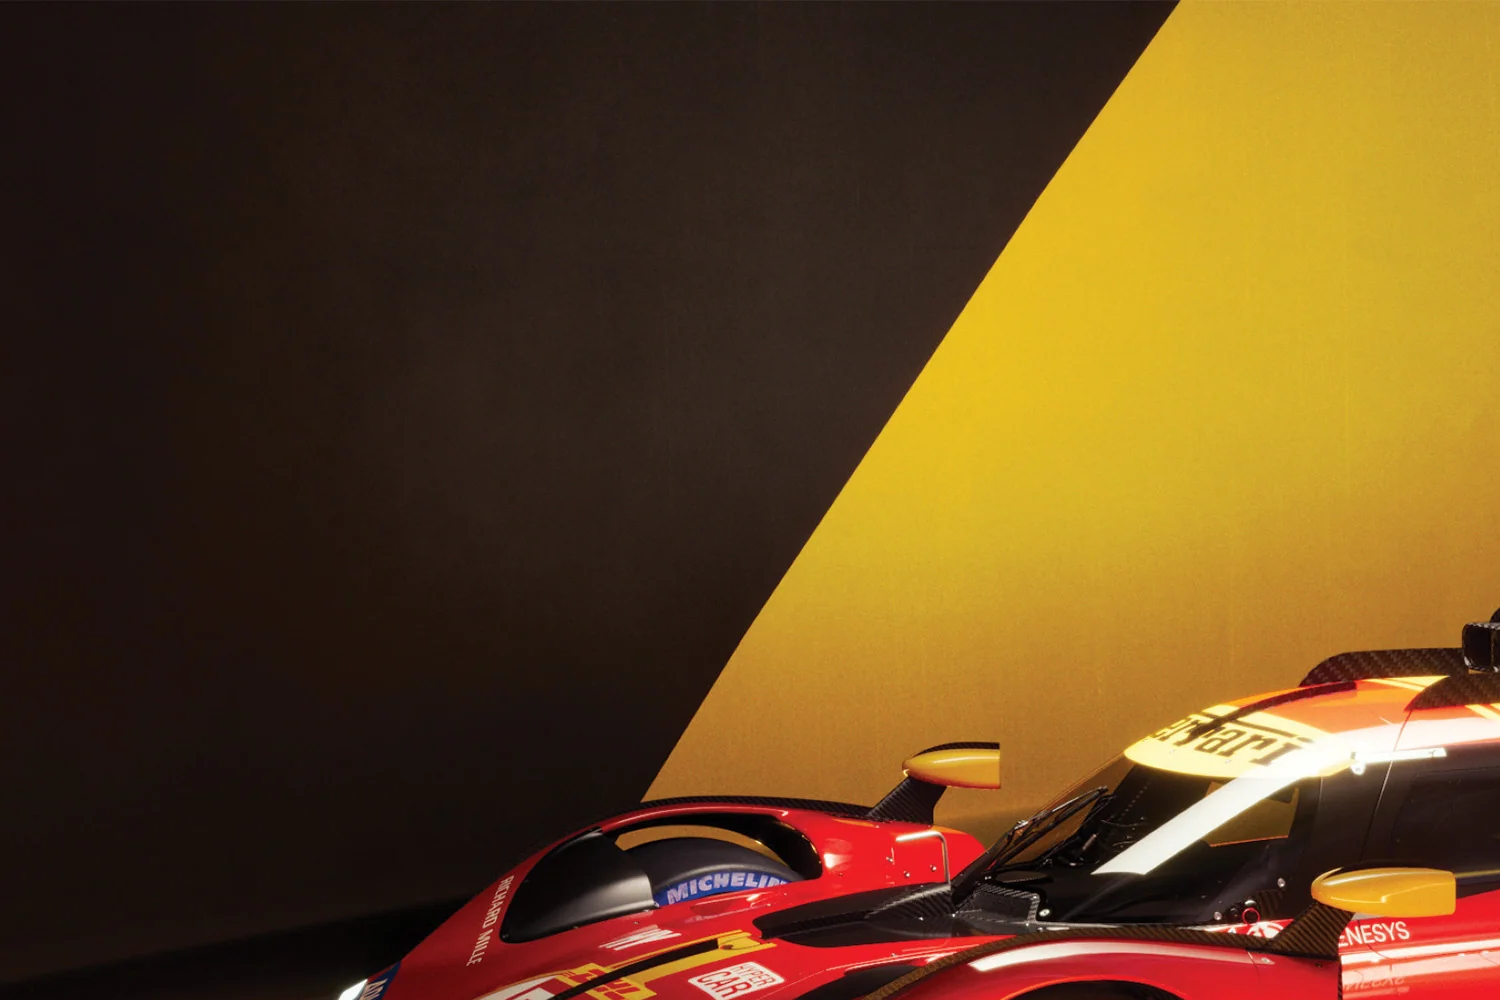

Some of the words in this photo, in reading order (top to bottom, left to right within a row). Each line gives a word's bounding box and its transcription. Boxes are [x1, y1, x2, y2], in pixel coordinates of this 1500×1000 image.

[483, 875, 515, 929] RICHARD
[466, 928, 494, 967] MILLE
[697, 971, 752, 998] CAR
